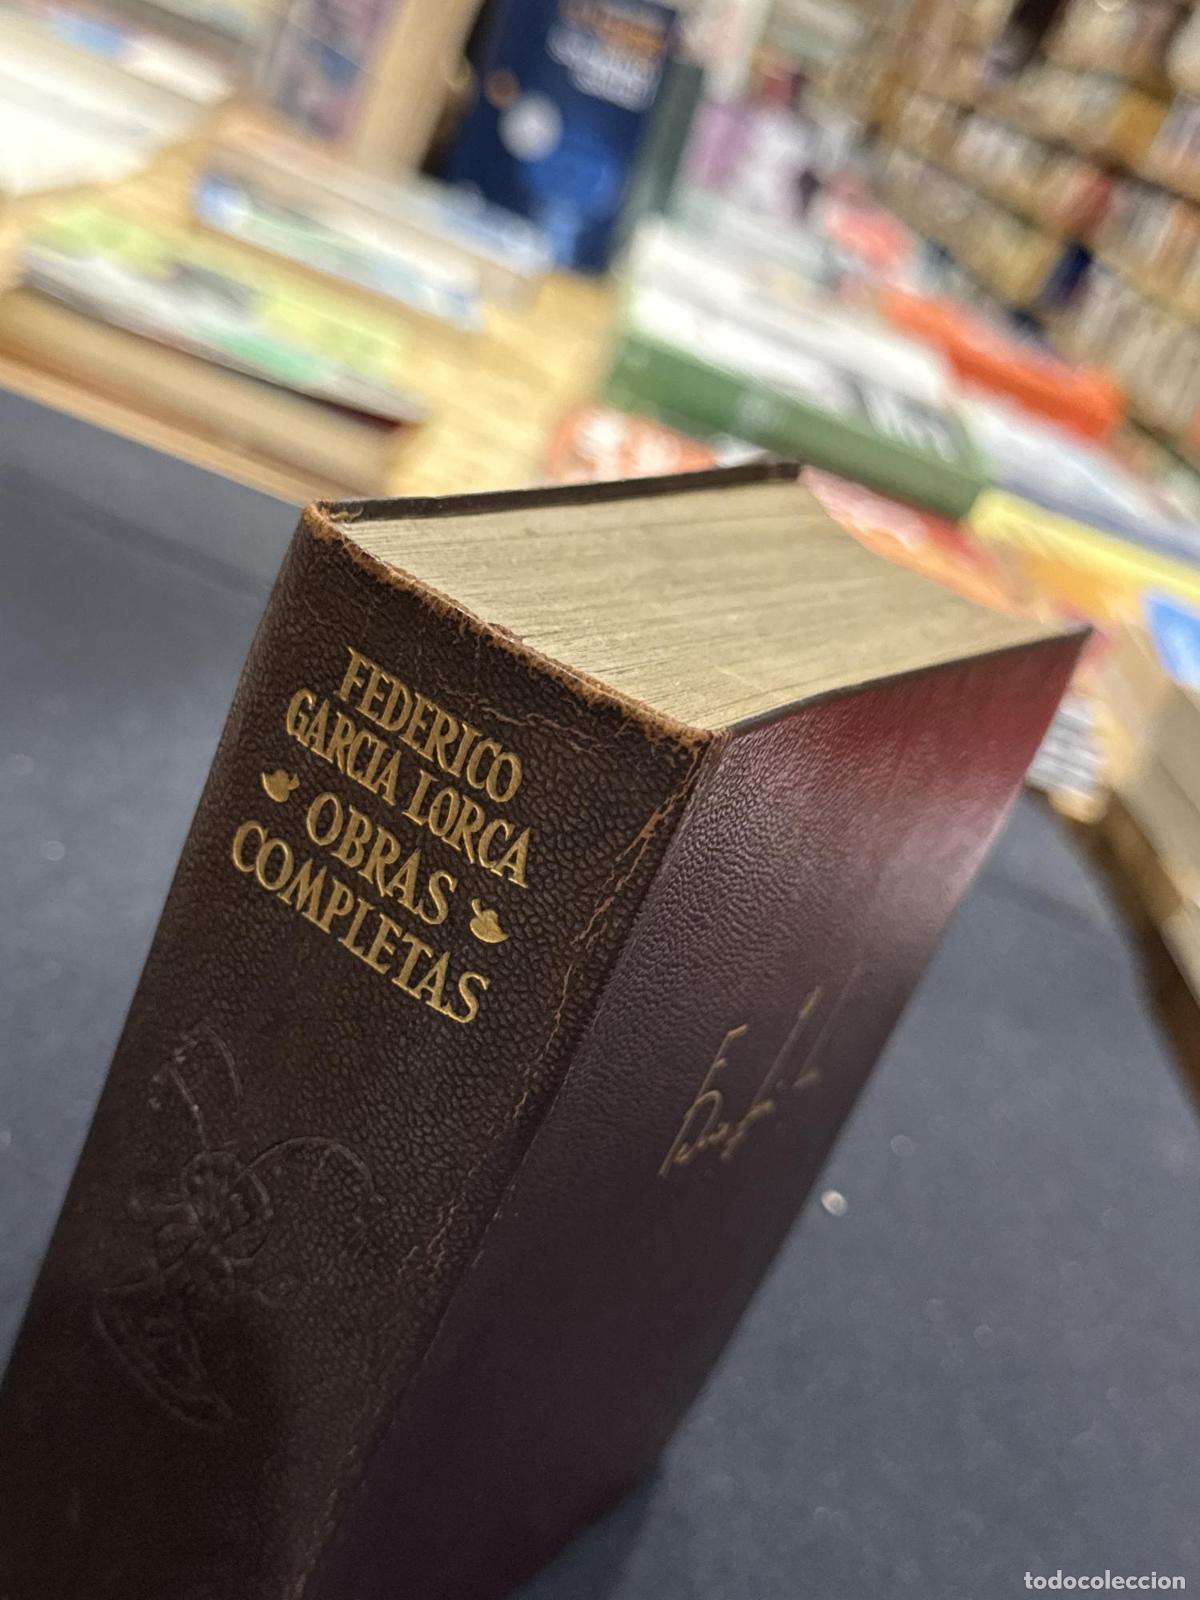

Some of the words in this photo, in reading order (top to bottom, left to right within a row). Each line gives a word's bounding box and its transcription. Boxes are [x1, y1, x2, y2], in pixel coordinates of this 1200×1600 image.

[286, 687, 401, 806] GARCIA
[402, 769, 532, 888] LORCA
[334, 646, 523, 803] FEDERICO
[232, 820, 490, 1023] COMPLETAS
[306, 792, 458, 925] OBRAS
